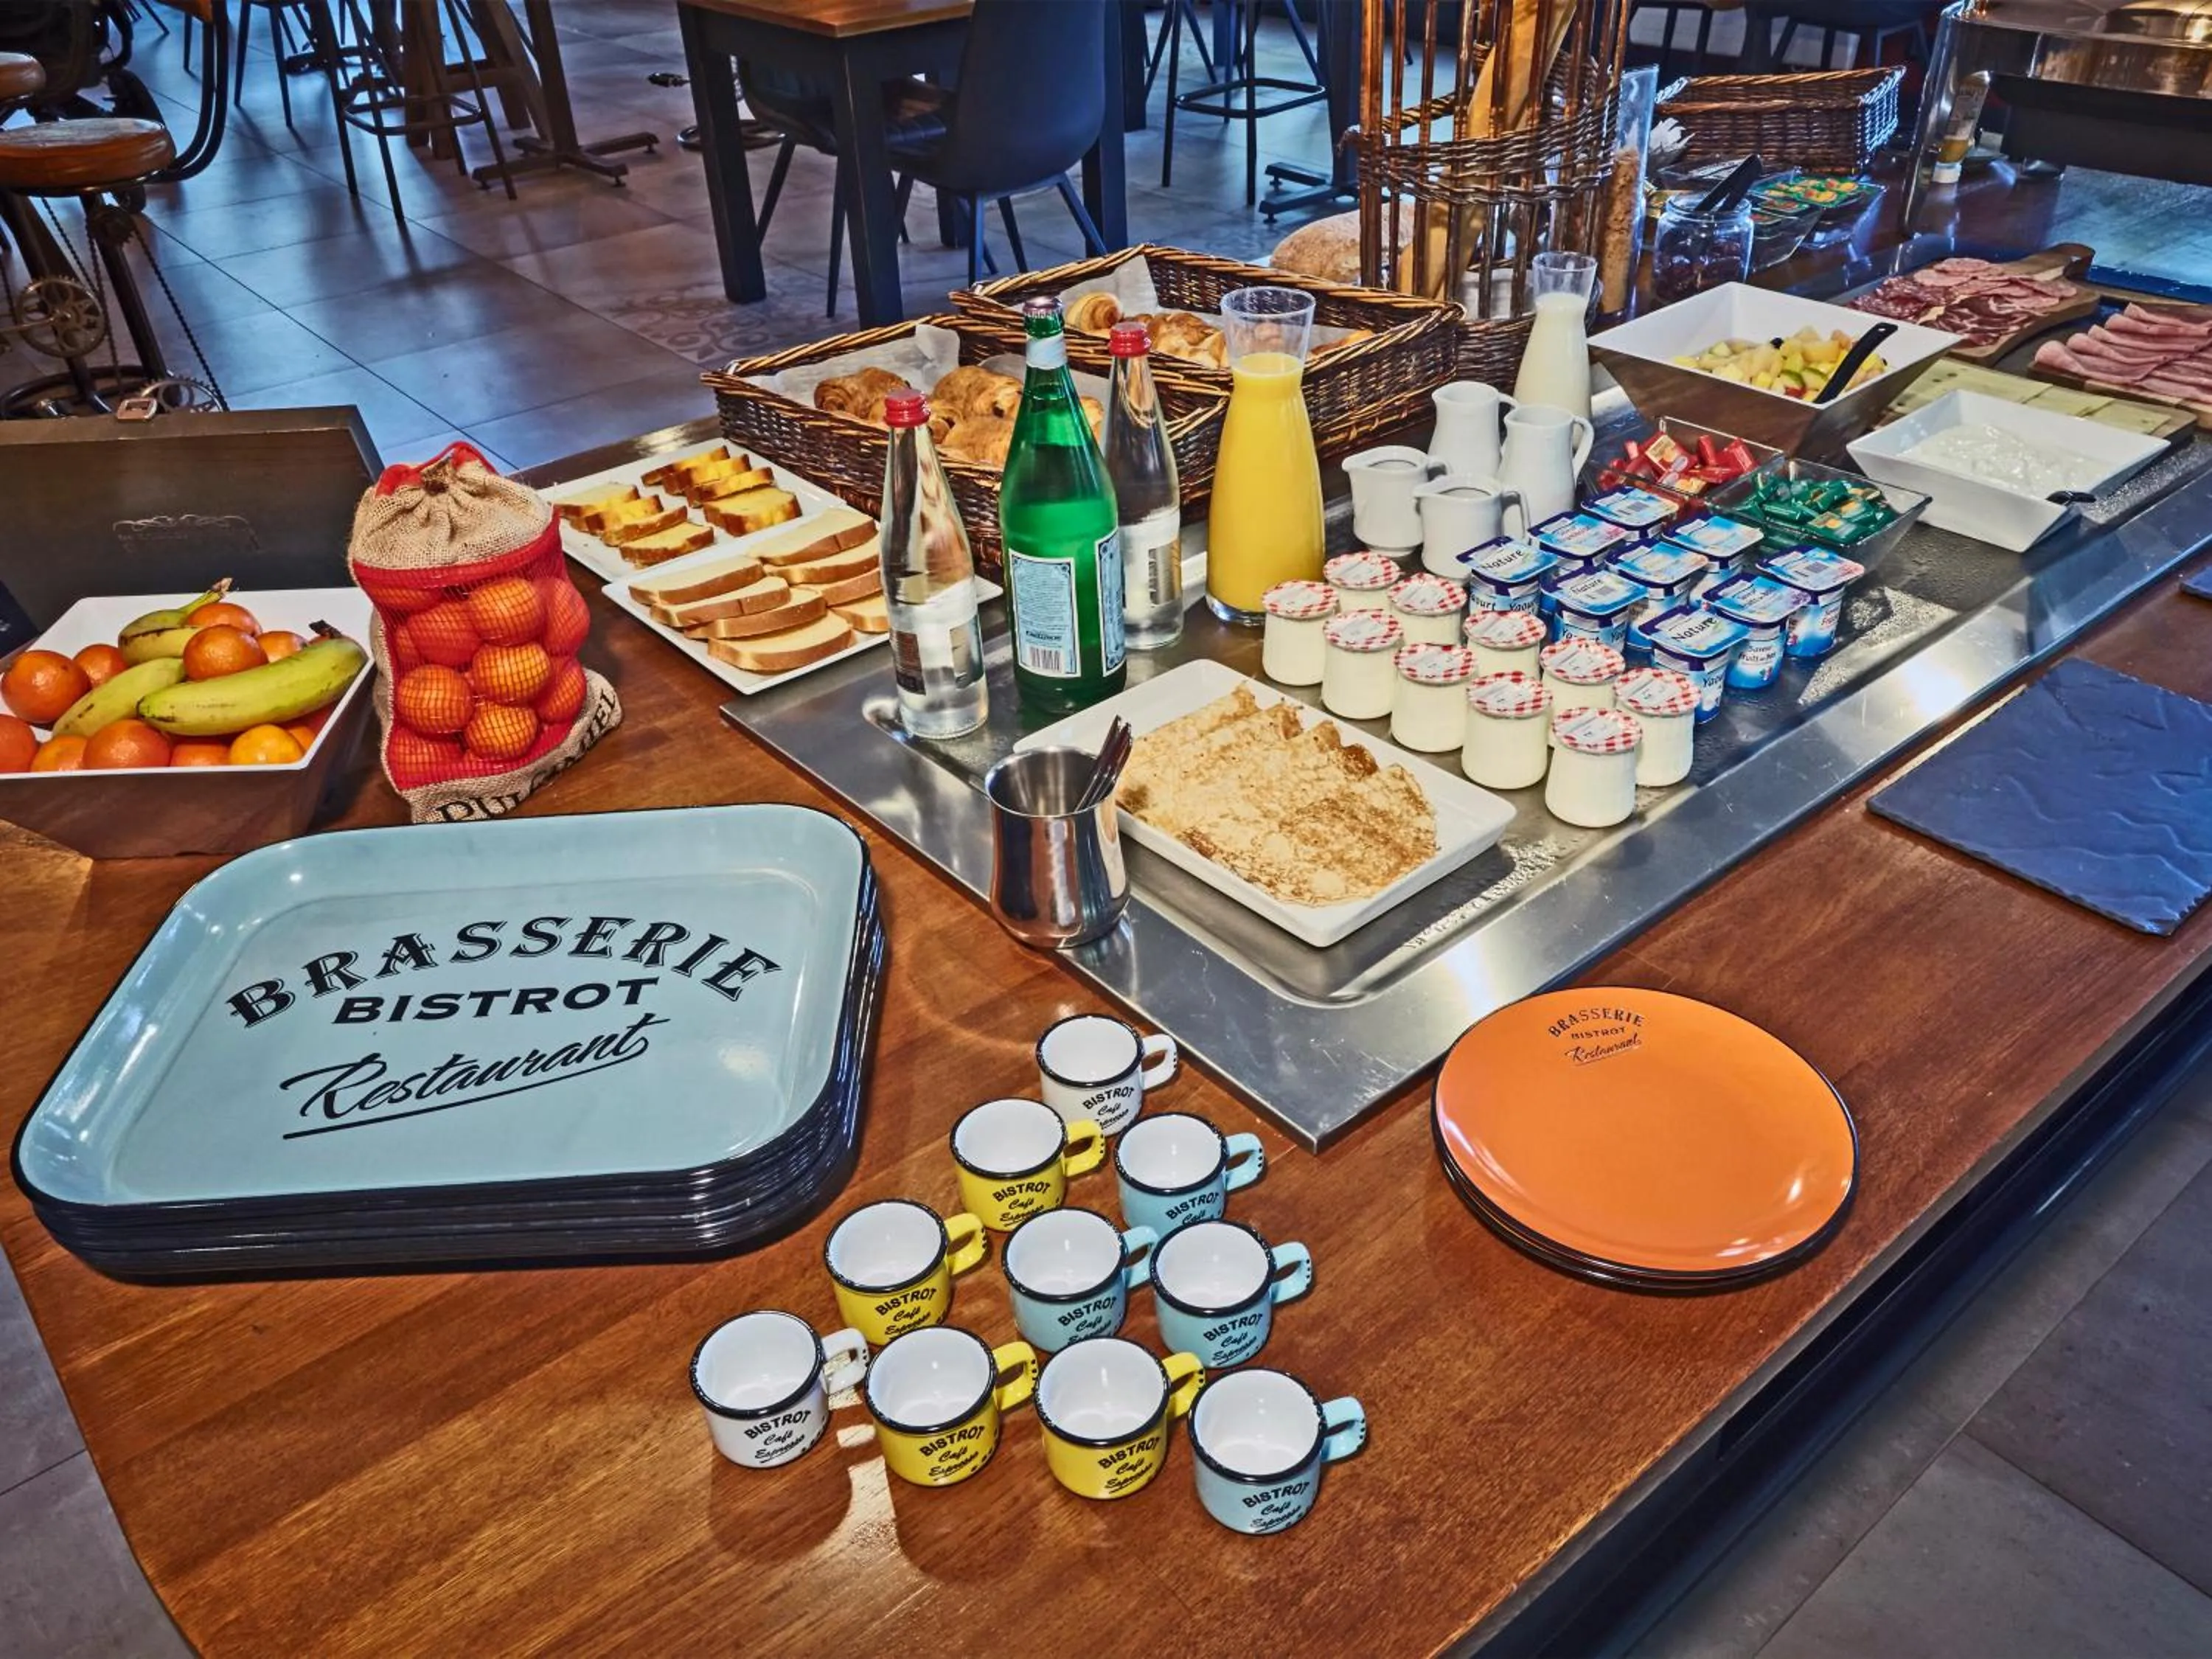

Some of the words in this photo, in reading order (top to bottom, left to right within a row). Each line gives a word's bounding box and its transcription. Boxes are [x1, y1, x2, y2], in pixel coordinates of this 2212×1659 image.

[1481, 549, 1524, 571] Nature
[1671, 616, 1717, 642] Nature
[224, 916, 783, 1028] BRASSERIE
[332, 977, 659, 1024] BISTROT
[1548, 1007, 1645, 1037] BRASSERIE
[1571, 1026, 1627, 1040] BISTROT
[1564, 1032, 1642, 1062] Restaurant
[279, 1012, 671, 1120] Restaurant
[1082, 1086, 1134, 1110] BISTROT
[992, 1181, 1051, 1203] BISTROT
[1165, 1192, 1220, 1220] BISTROT
[874, 1287, 937, 1316] BISTROT
[1057, 1295, 1117, 1326] BISTROT
[1203, 1312, 1263, 1341] BISTROT
[743, 1409, 811, 1440] BISTROT
[754, 1433, 806, 1459] Espresso
[919, 1425, 986, 1457] BISTROT
[1097, 1436, 1161, 1470] BISTROT
[928, 1450, 979, 1477] Espresso
[1242, 1480, 1310, 1509] BISTROT
